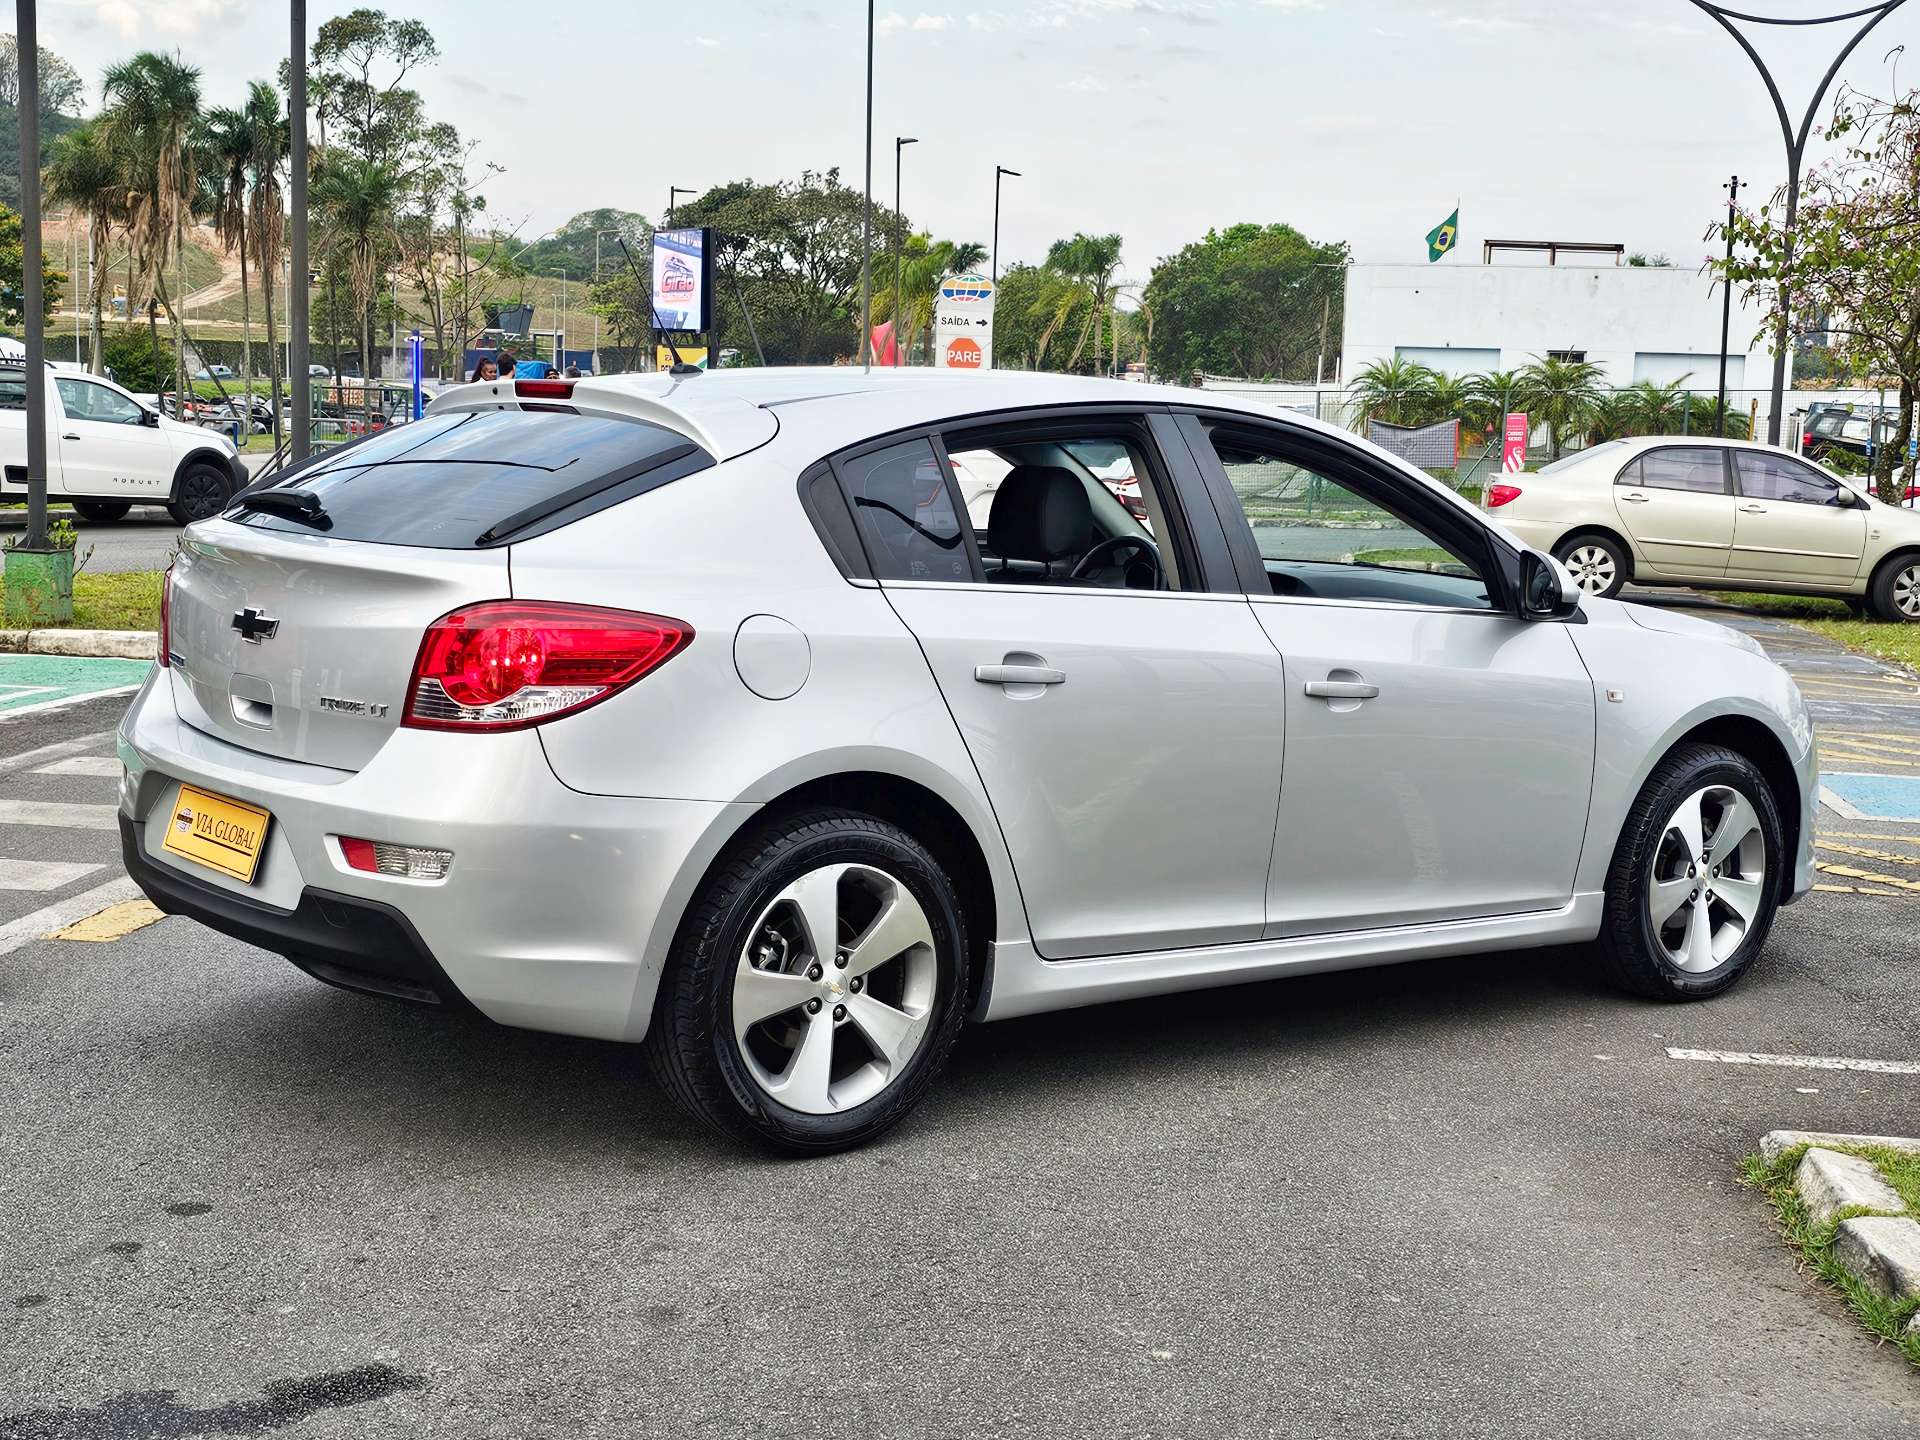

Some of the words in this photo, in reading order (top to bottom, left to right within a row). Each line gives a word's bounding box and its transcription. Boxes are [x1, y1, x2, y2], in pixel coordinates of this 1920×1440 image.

[941, 315, 970, 326] SAÍDA
[947, 350, 981, 363] PARE
[196, 812, 213, 835] VIA
[215, 820, 255, 850] GLOBAL
